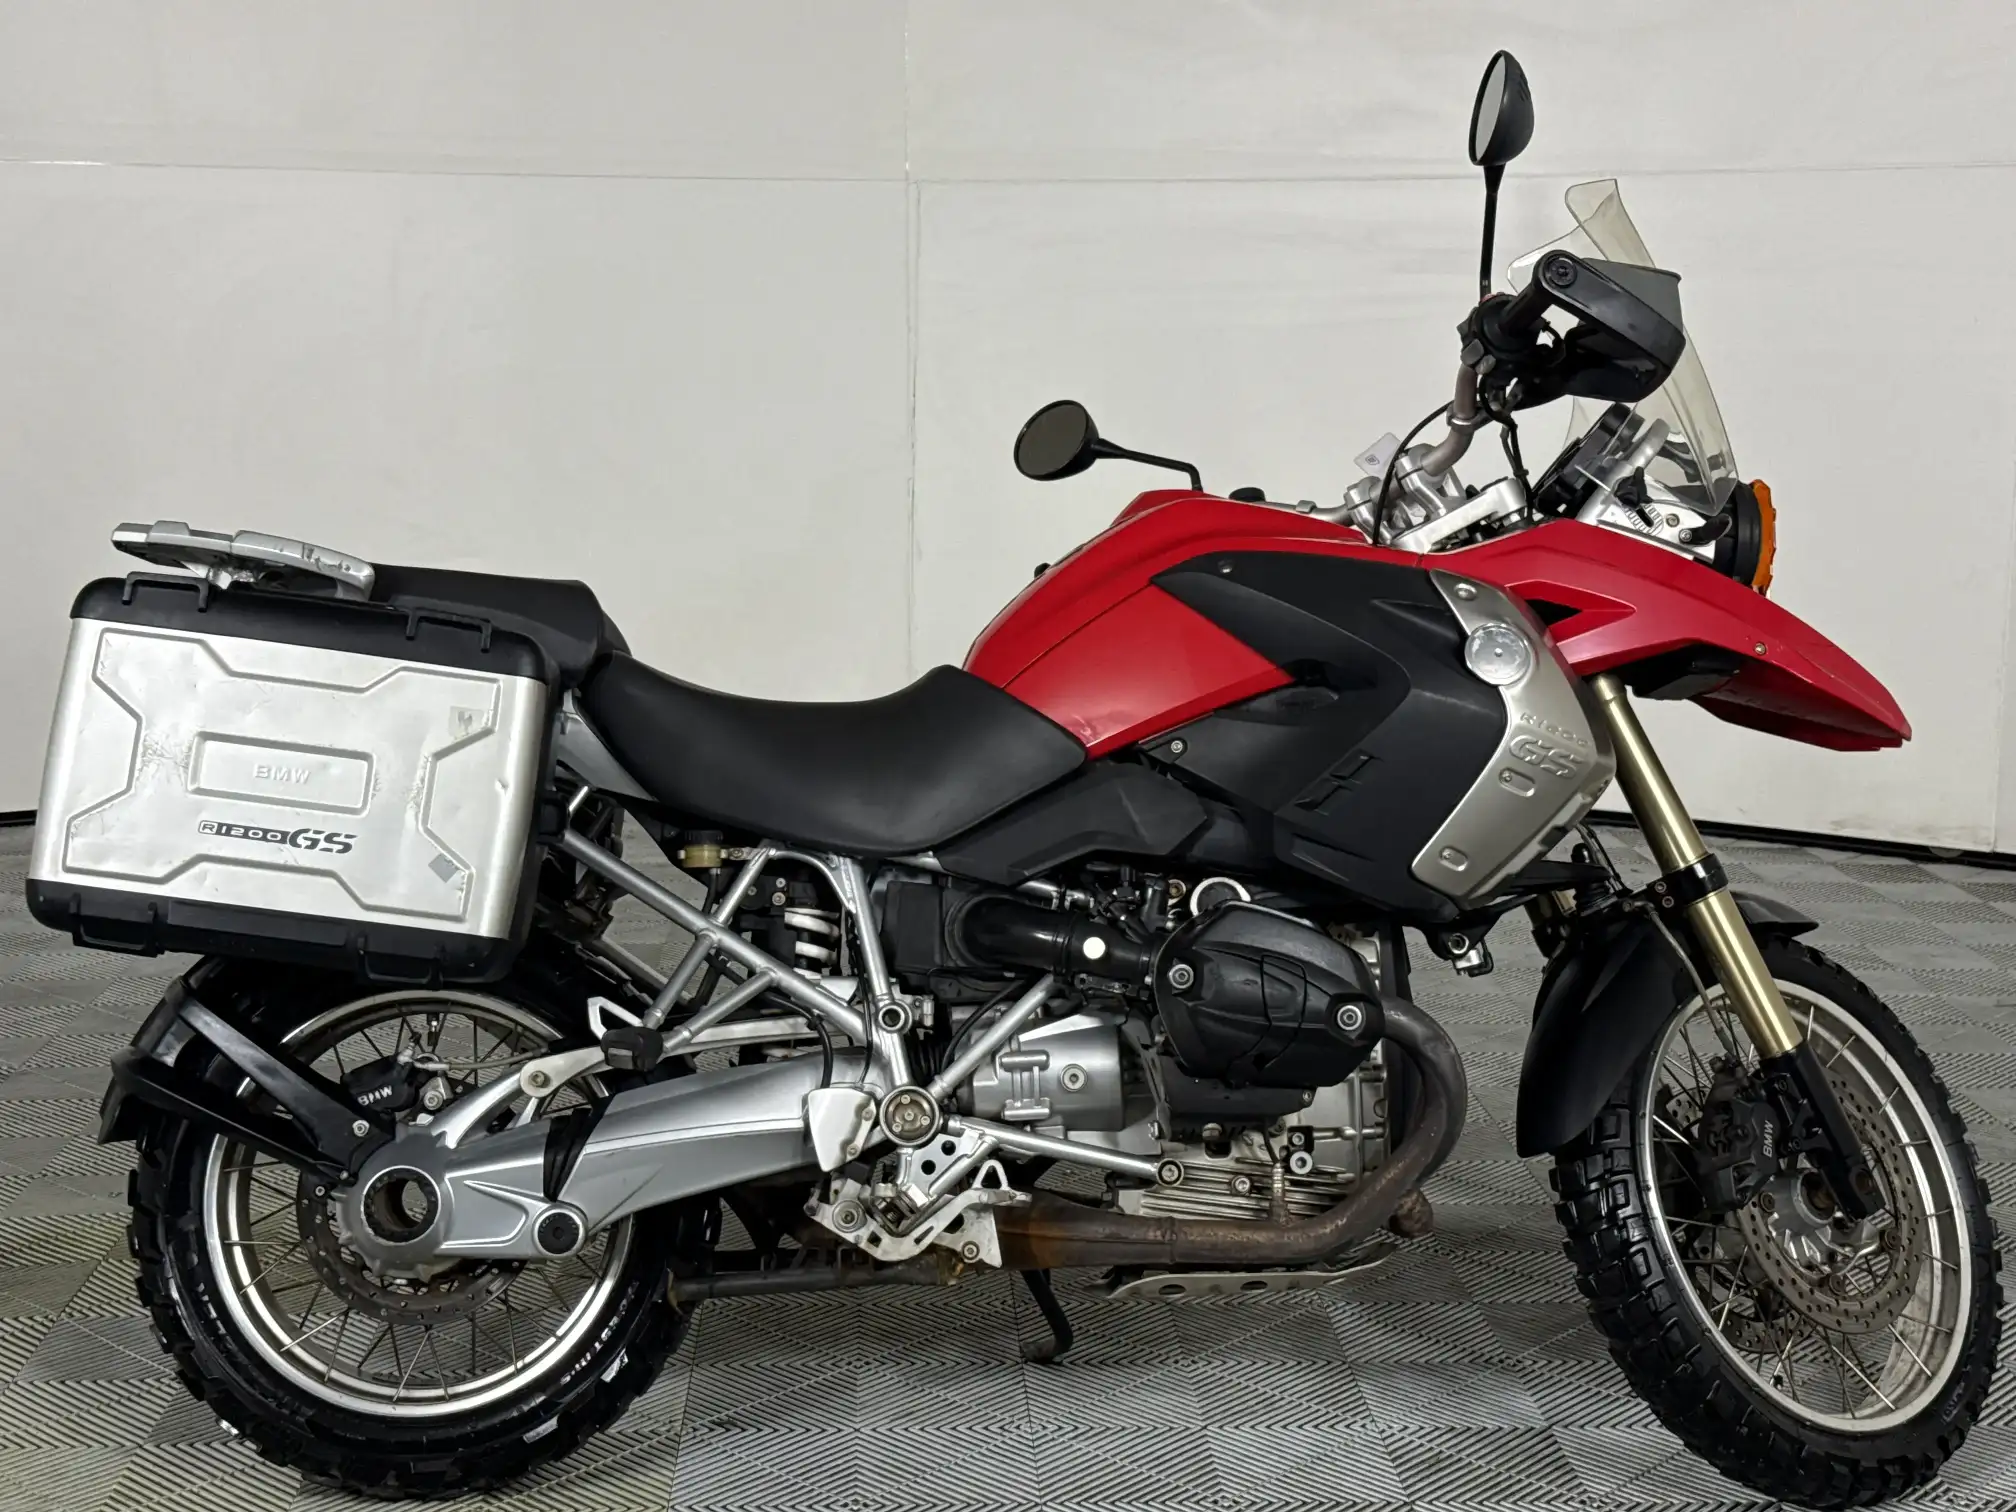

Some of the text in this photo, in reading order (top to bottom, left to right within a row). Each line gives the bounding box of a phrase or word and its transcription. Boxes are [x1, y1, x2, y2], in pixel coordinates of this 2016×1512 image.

[1509, 734, 1585, 780] GS
[253, 762, 312, 785] BMW
[357, 1085, 393, 1106] BMW
[1762, 1119, 1774, 1158] BMW
